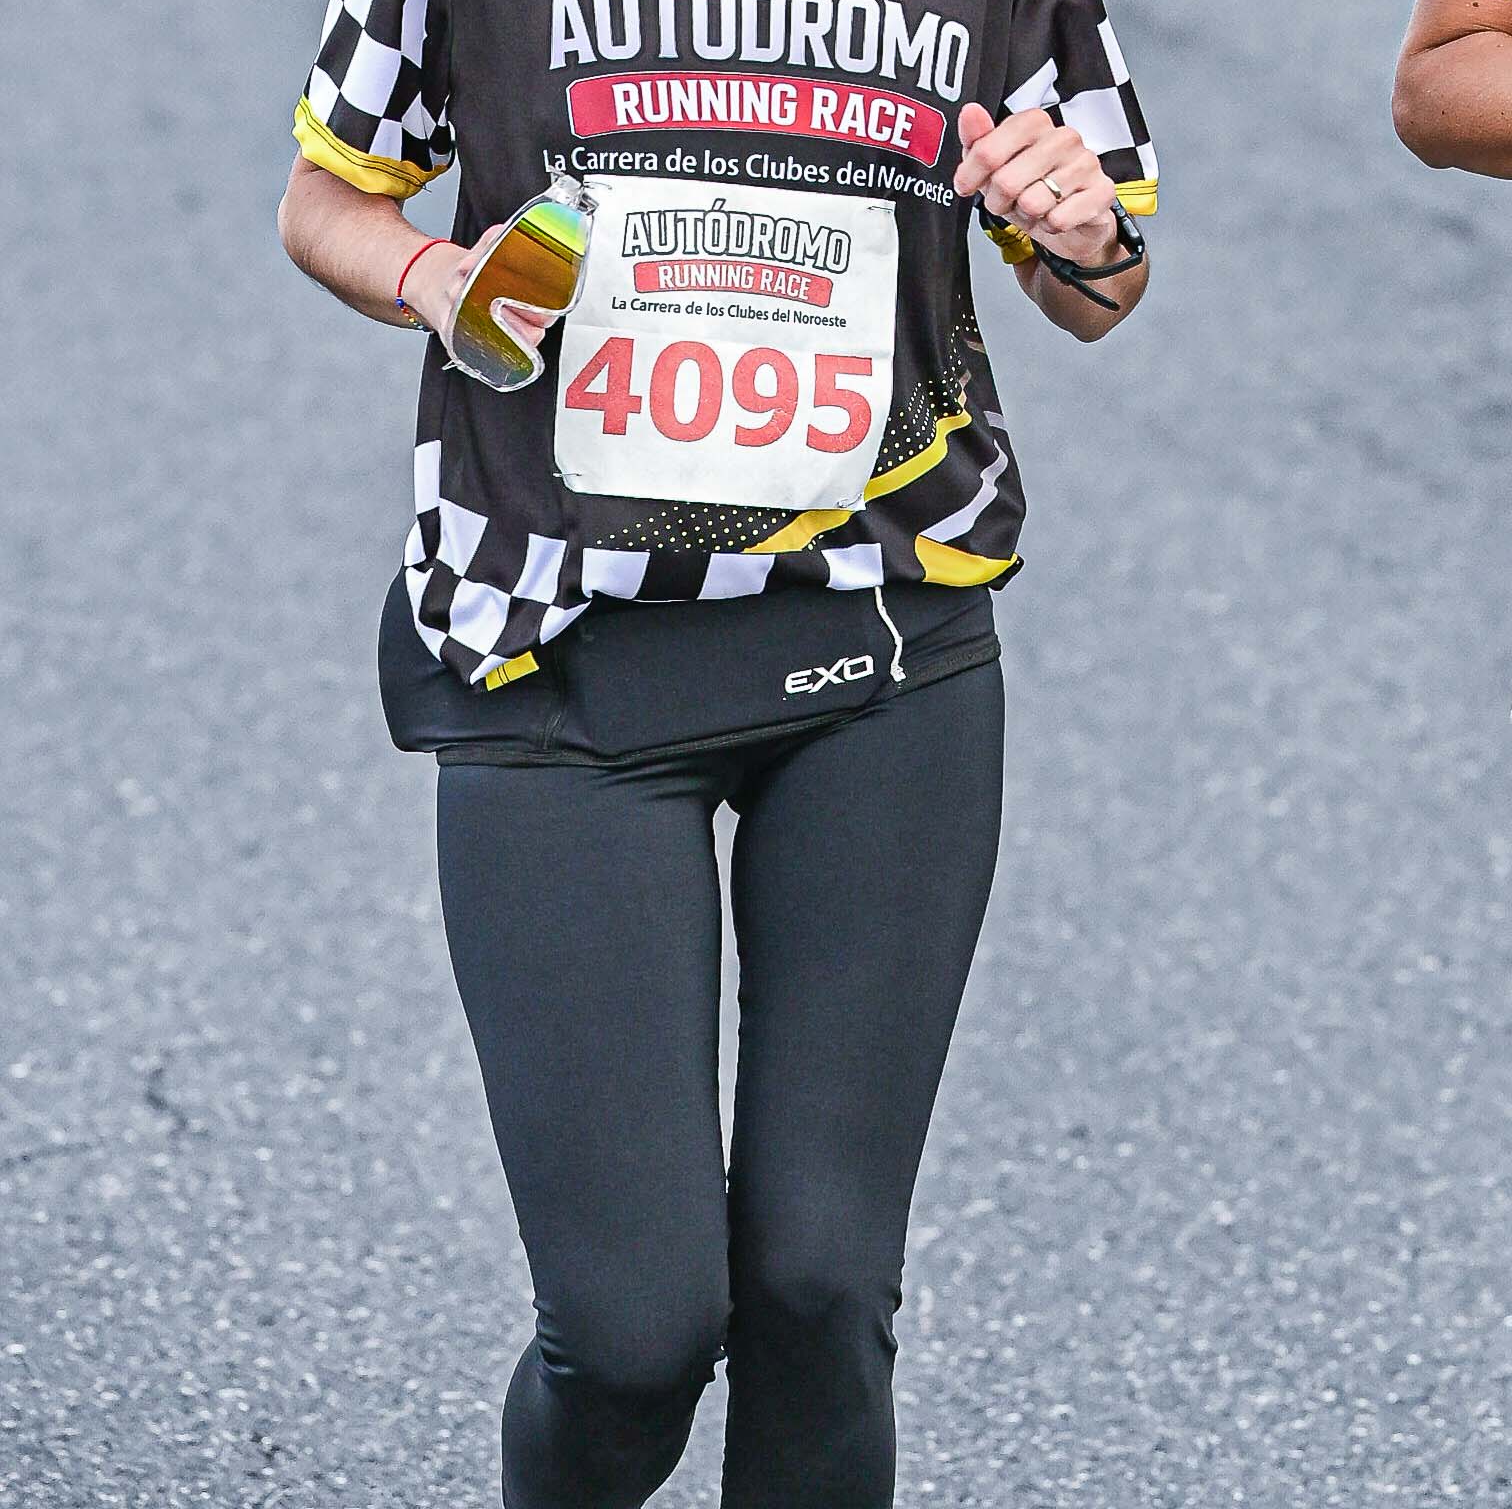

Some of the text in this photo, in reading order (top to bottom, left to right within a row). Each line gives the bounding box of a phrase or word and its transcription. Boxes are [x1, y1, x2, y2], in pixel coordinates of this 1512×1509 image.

[611, 78, 915, 149] RUNNING RACE
[543, 147, 954, 207] La Carrera de los Clubes del Noroeste
[622, 198, 851, 274] AUTÓDROMO
[611, 296, 847, 328] La Carrera de los Clubes del Noroeste
[657, 264, 812, 301] RUNNING RACE
[565, 337, 873, 454] 4095
[784, 654, 874, 694] EXO
